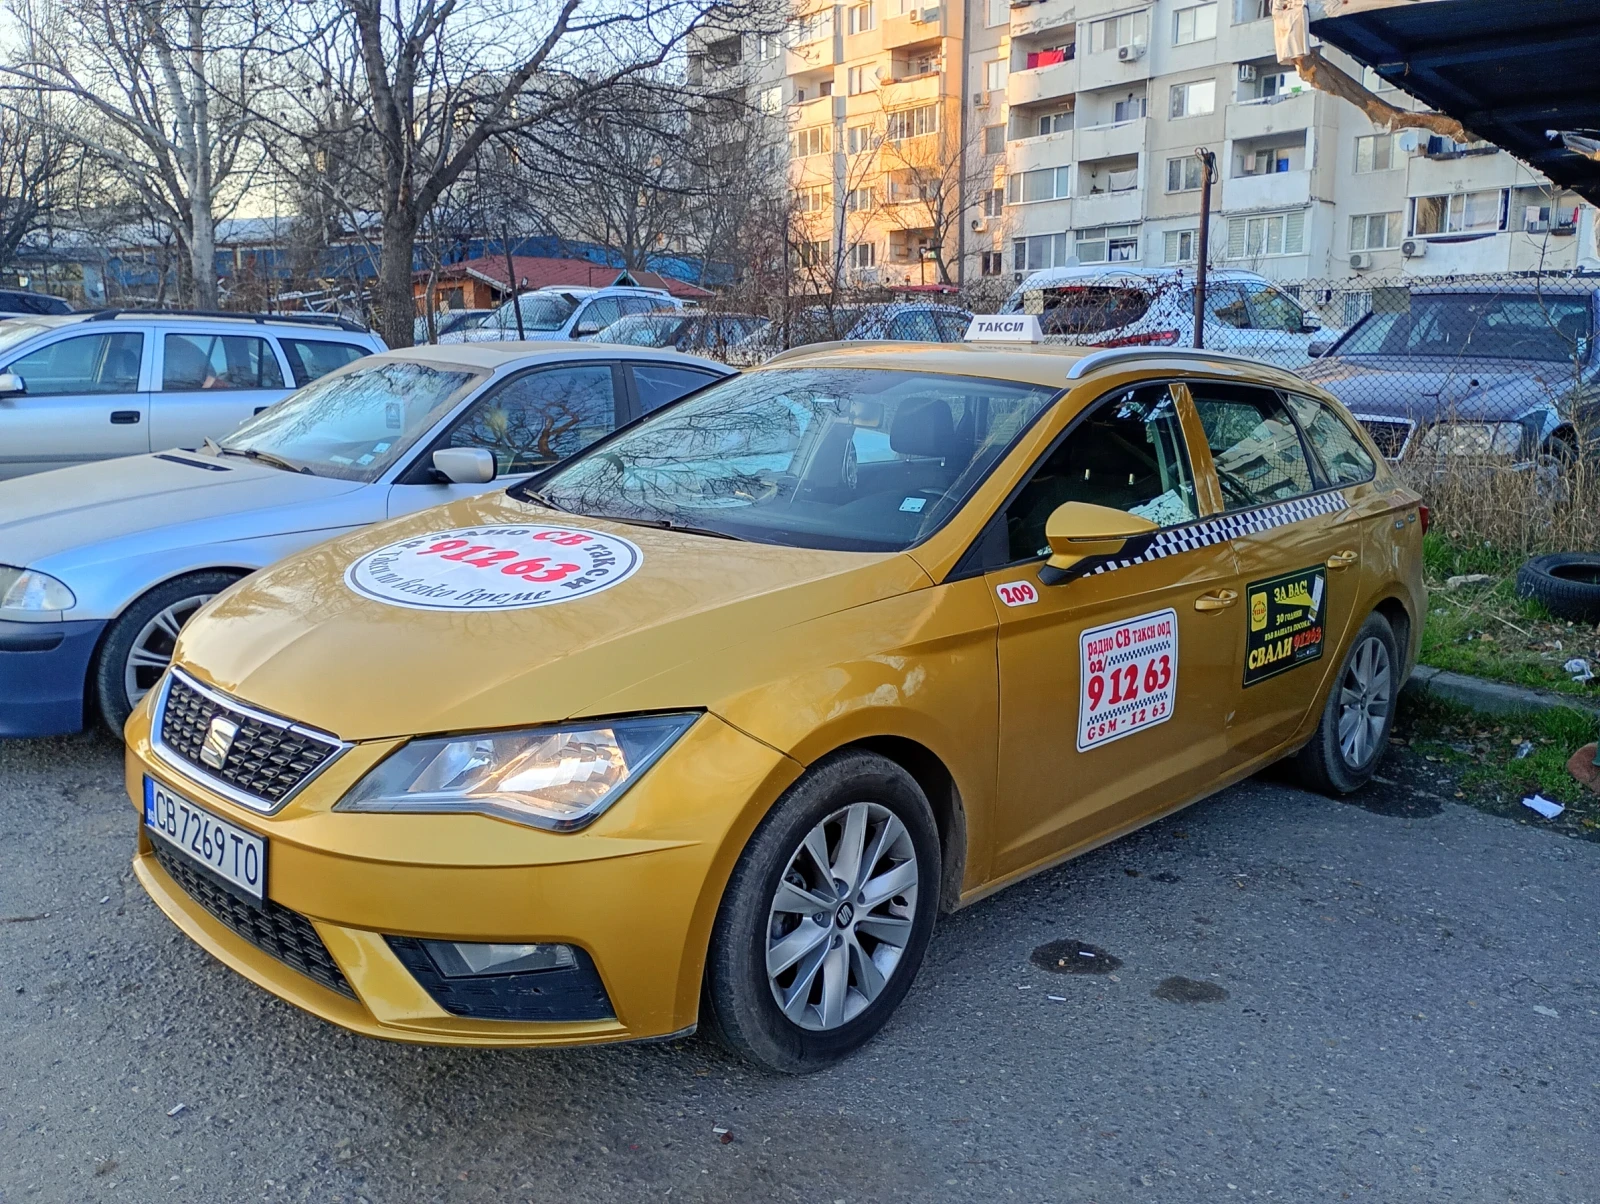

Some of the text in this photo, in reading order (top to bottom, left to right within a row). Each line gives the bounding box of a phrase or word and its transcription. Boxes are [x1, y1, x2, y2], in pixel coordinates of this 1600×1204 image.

[978, 322, 1024, 332] ТАКСИ
[533, 531, 594, 546] СВ
[560, 544, 616, 589] такси
[375, 573, 404, 584] по
[391, 579, 457, 598] всяко
[454, 588, 549, 605] време
[1001, 584, 1034, 604] 209
[1273, 586, 1287, 602] ЗА
[1275, 613, 1285, 626] 30
[1115, 628, 1131, 649] СВ
[1132, 625, 1156, 644] такси
[1157, 621, 1172, 639] оод
[1248, 636, 1293, 670] СВАЛИ
[1293, 626, 1322, 652] 91263
